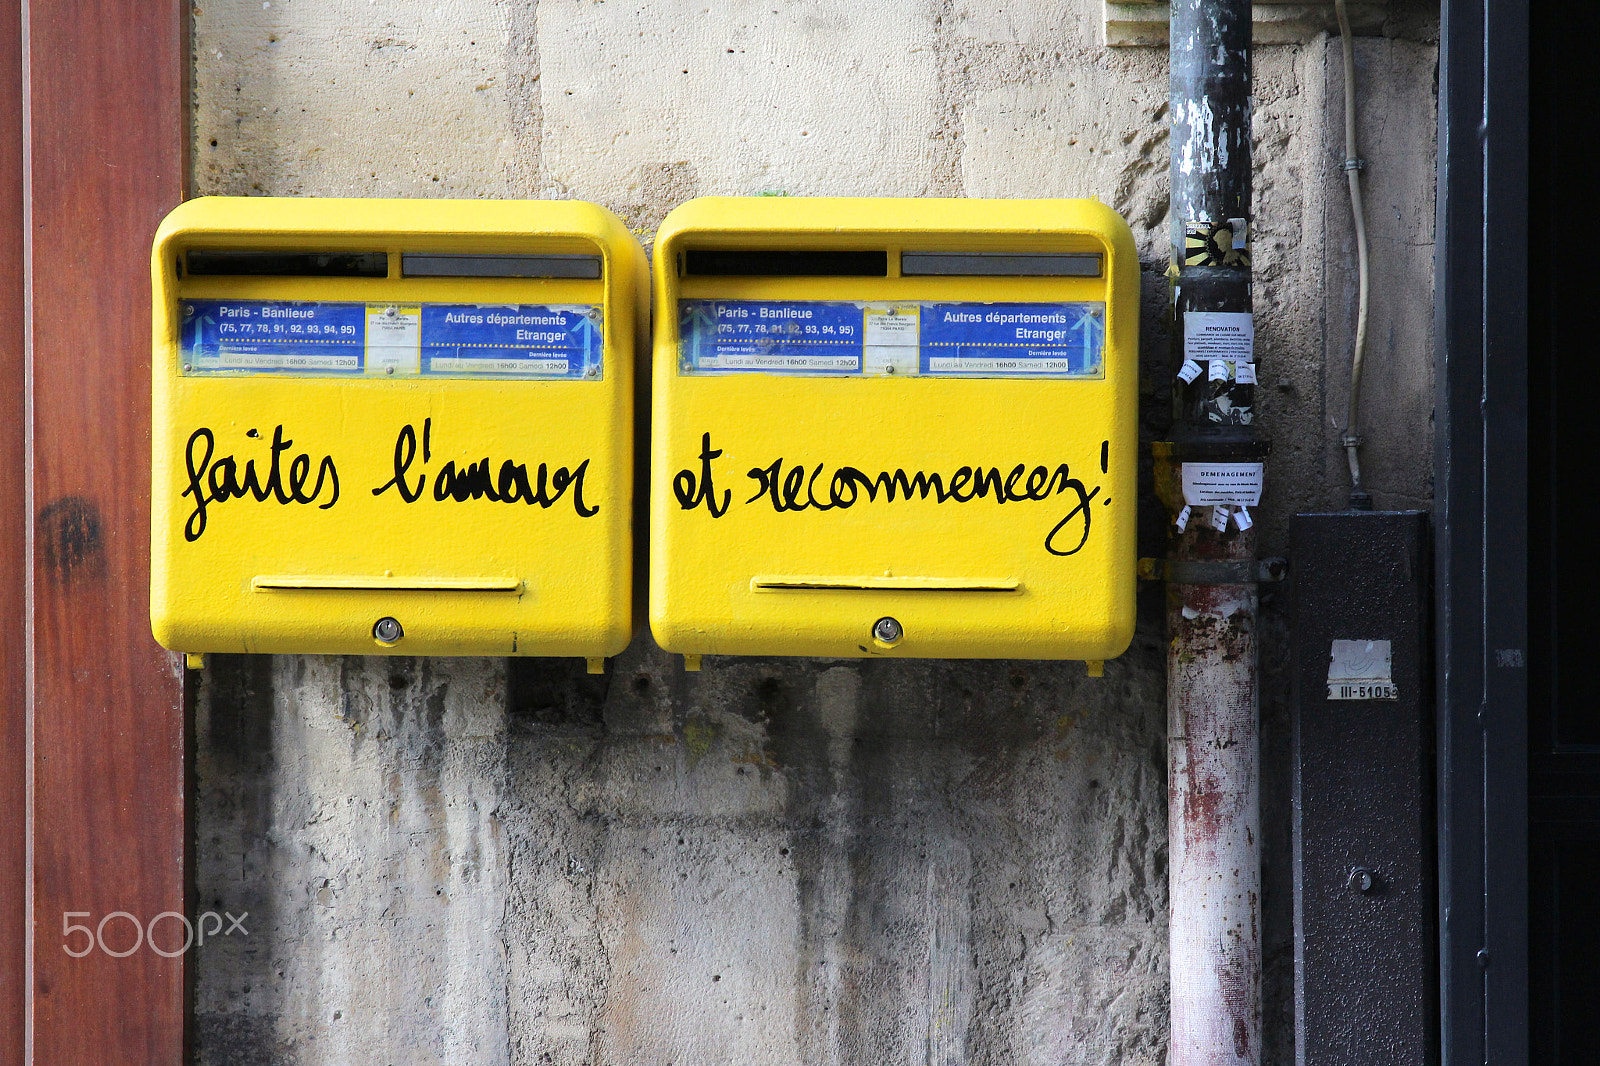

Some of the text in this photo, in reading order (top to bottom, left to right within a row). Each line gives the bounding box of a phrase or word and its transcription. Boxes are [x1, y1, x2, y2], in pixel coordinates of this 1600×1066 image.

[219, 307, 250, 318] Paris
[261, 307, 315, 319] Banlieue
[717, 306, 748, 318] Paris
[759, 307, 813, 319] Banlieue
[943, 311, 1067, 325] Autres départements
[444, 312, 567, 327] Autres départements
[219, 323, 356, 335] (75, 77, 78, 91, 92, 93, 94, 95)
[717, 324, 854, 336] (75, 77, 78, 91, 92, 93, 94, 95)
[1015, 328, 1067, 341] Etranger
[516, 329, 567, 343] Etranger
[224, 356, 242, 364] Lundi
[254, 356, 284, 366] Vendredi
[285, 358, 307, 366] 16h00
[308, 358, 333, 367] Samedi
[335, 358, 356, 367] 12h00
[496, 362, 517, 370] 16h00
[519, 361, 544, 370] Samedi
[546, 362, 567, 370] 12h00
[725, 357, 744, 366] Lundi
[755, 357, 785, 367] Vendredi
[786, 358, 807, 367] 16h00
[808, 358, 834, 367] Samedi
[836, 359, 857, 368] 12h00
[964, 360, 994, 369] Vendredi
[995, 361, 1017, 369] 16h00
[1018, 360, 1044, 369] Samedi
[1045, 361, 1067, 369] 12h00
[181, 417, 600, 542] faites l'amour
[673, 431, 732, 519] et
